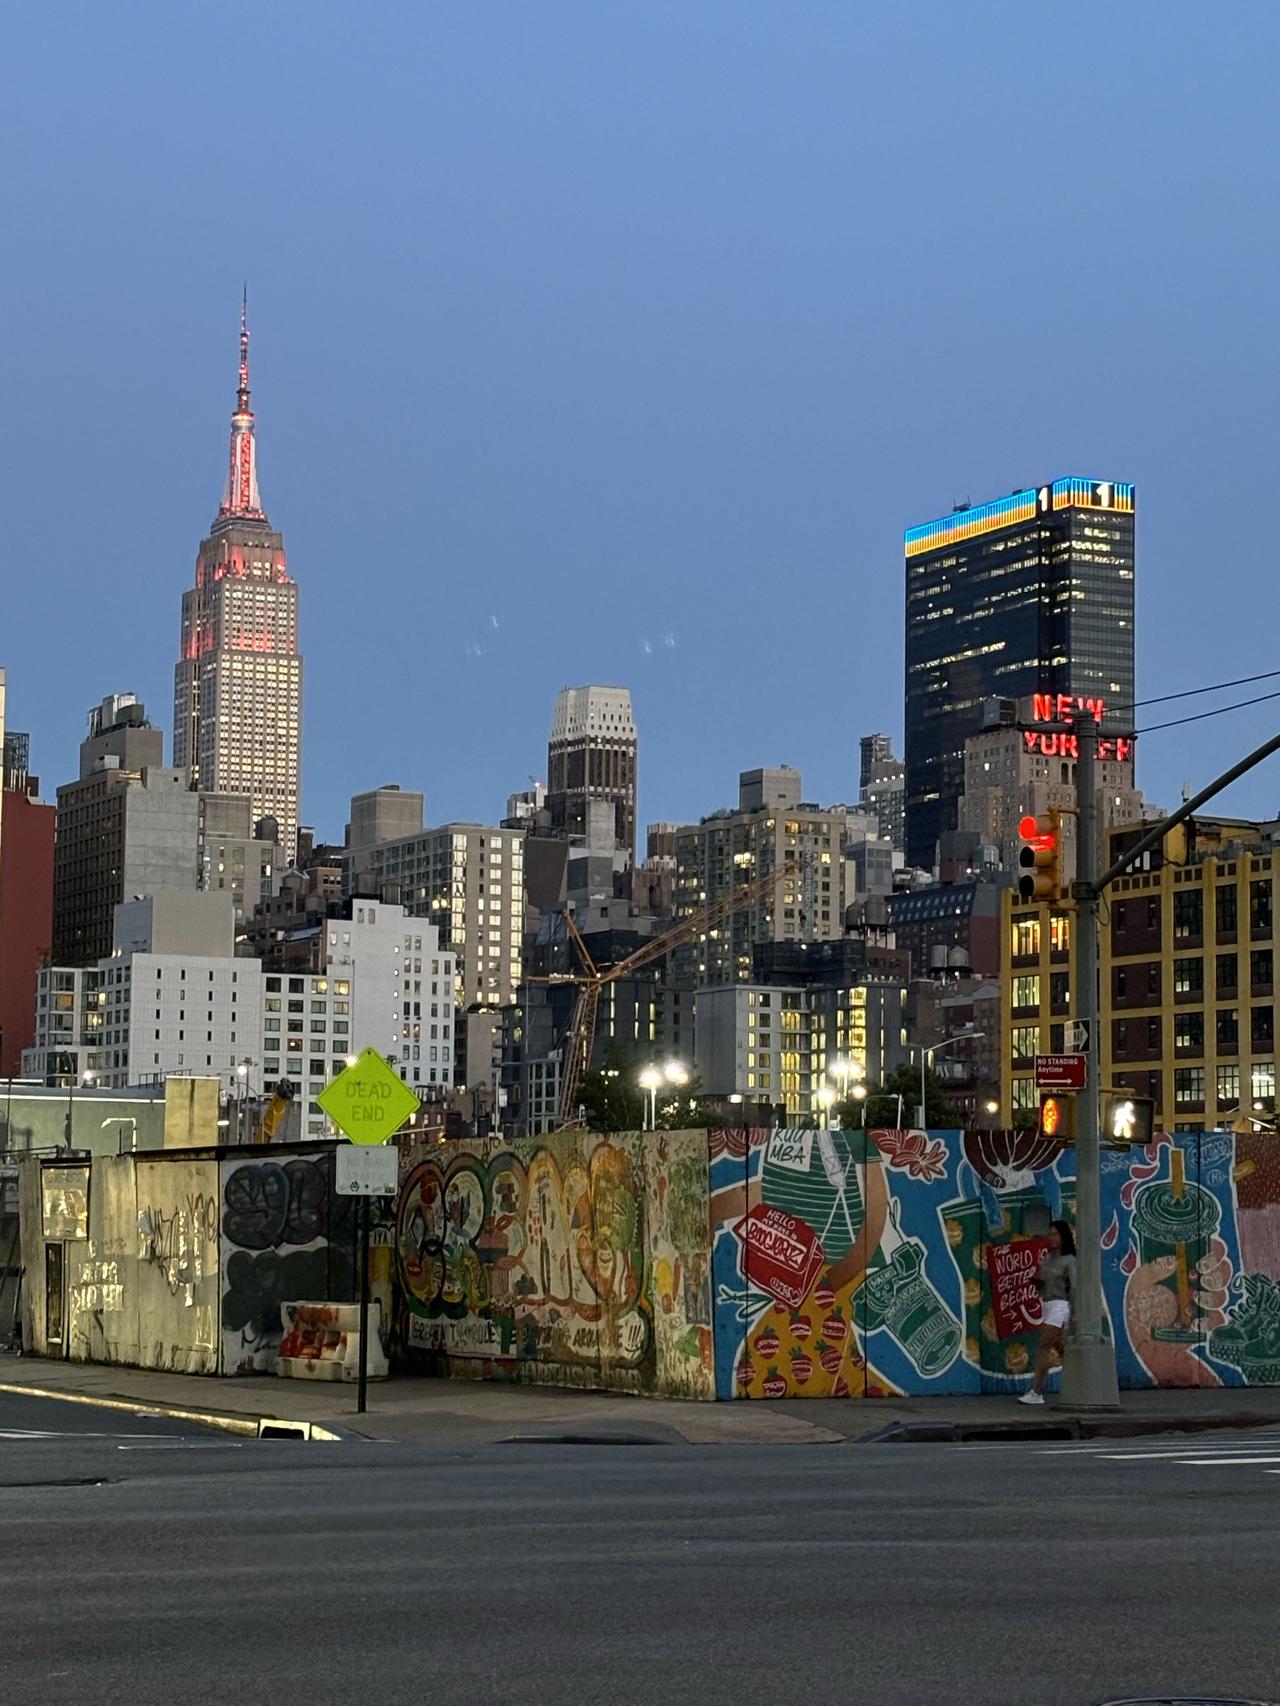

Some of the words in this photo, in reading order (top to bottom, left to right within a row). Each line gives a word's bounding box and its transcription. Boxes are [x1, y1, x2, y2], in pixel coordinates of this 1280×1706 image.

[1039, 487, 1048, 511] 1
[1097, 483, 1109, 507] 1
[1032, 693, 1104, 723] NEW
[1024, 731, 1132, 761] YORER
[345, 1082, 392, 1099] DEAD
[352, 1105, 385, 1121] END
[770, 1145, 806, 1164] MBA
[766, 1209, 796, 1230] HELLO
[992, 1244, 1012, 1256] THE
[995, 1249, 1033, 1274] WORLD
